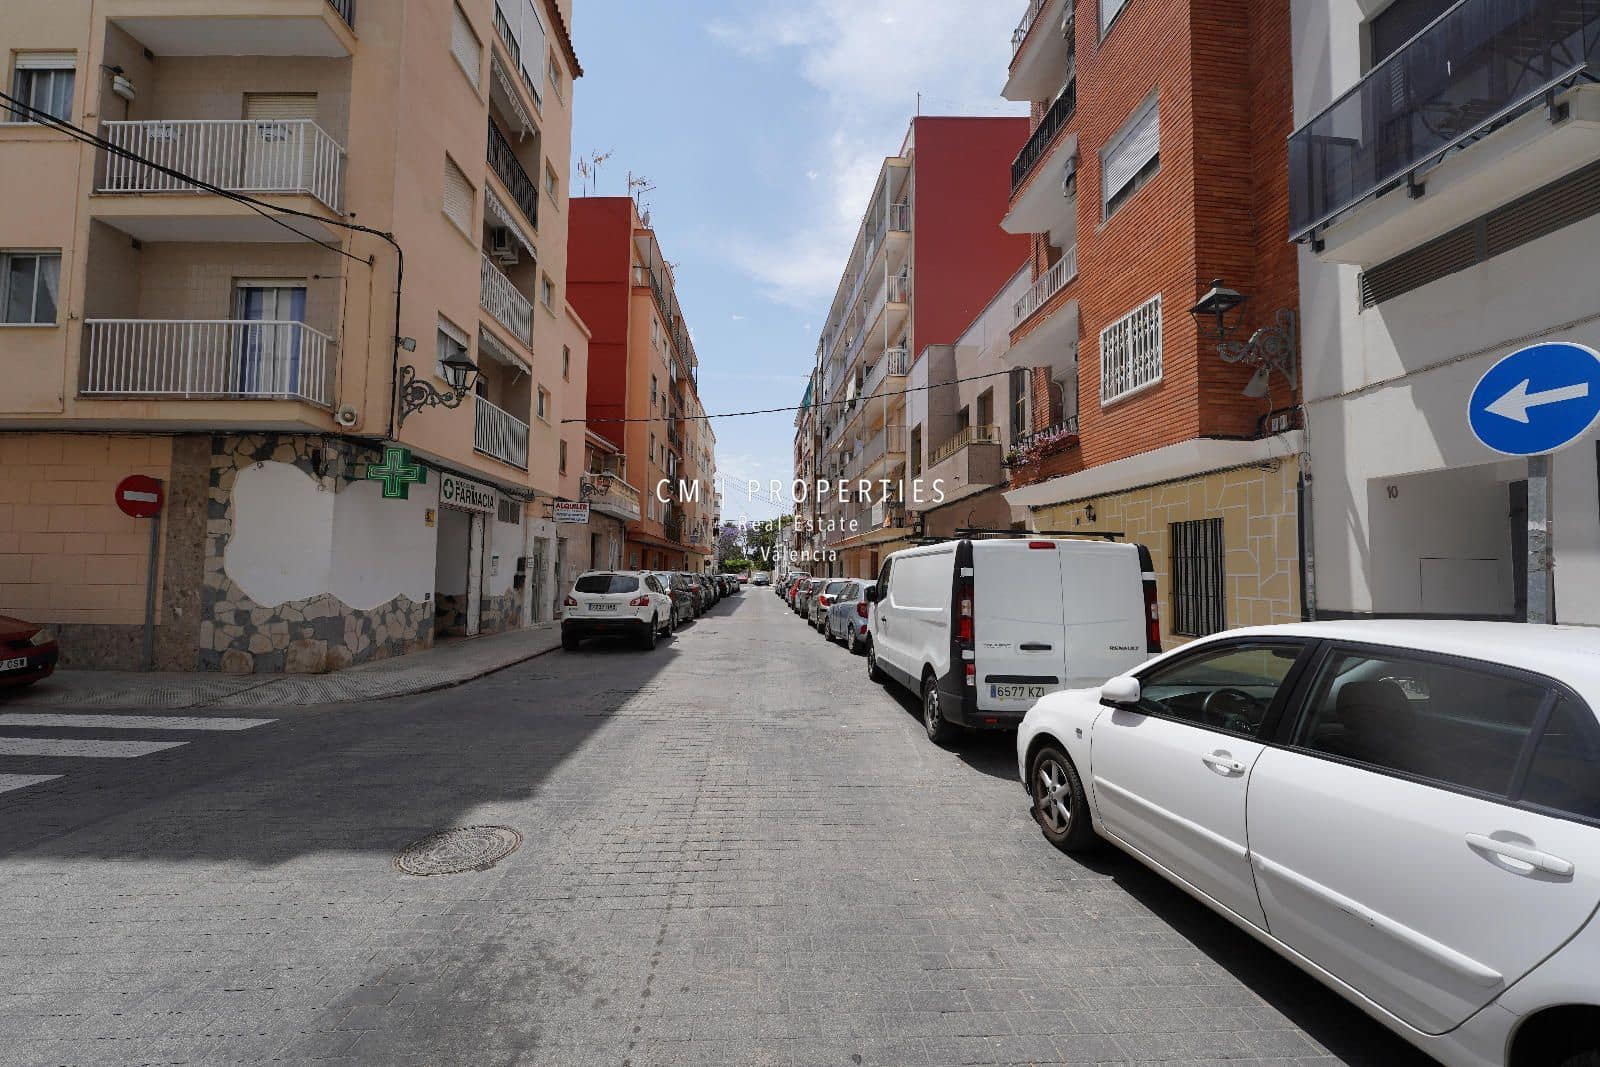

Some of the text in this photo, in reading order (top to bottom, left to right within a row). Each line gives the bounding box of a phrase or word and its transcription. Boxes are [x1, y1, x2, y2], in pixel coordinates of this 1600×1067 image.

[455, 486, 494, 508] FARMACIA
[1387, 485, 1399, 499] 10
[555, 502, 588, 510] ALQUILER
[997, 686, 1025, 697] 6577
